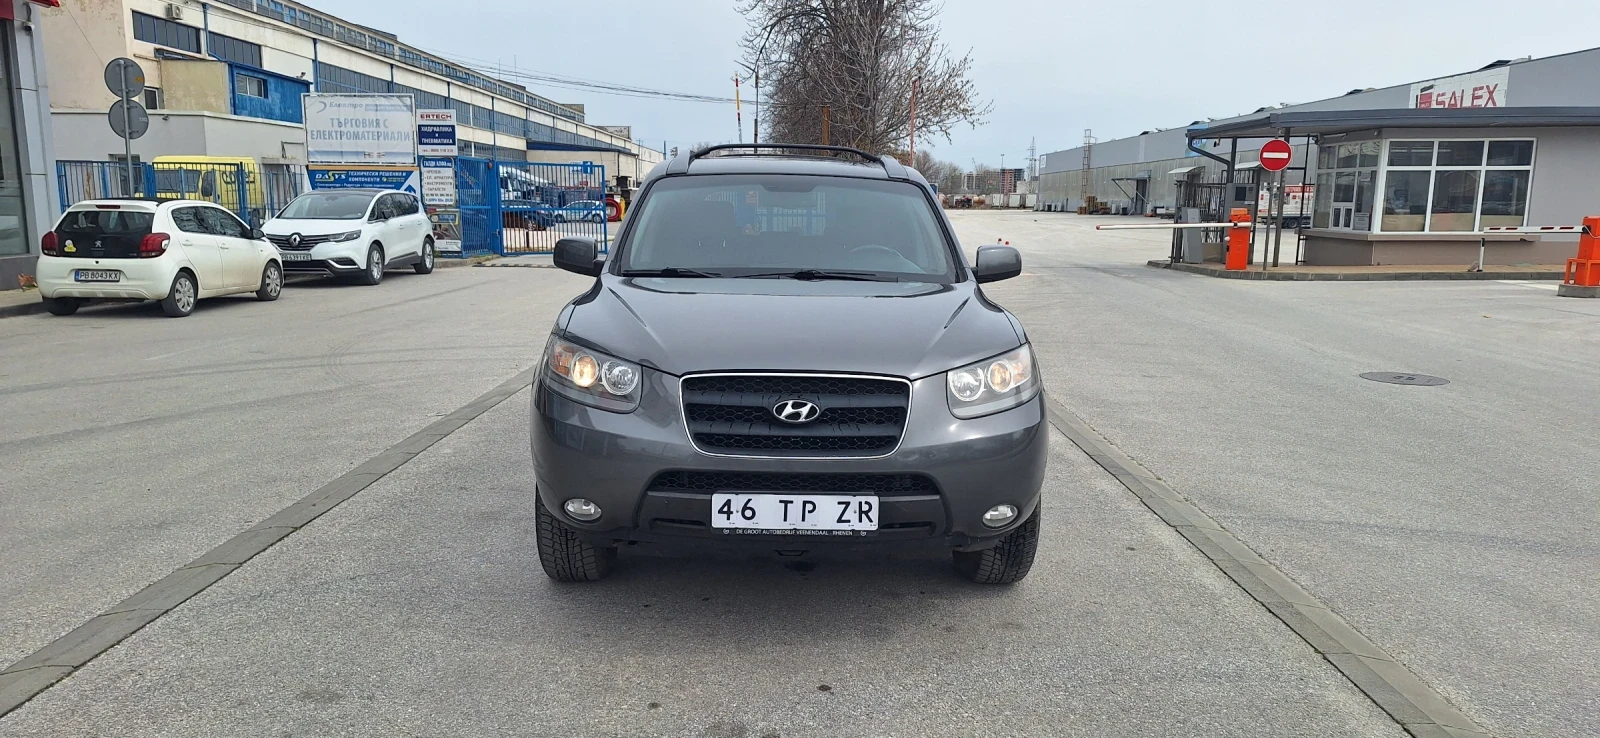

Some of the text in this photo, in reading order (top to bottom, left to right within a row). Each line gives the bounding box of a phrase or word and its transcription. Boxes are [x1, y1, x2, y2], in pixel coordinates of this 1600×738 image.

[1435, 83, 1499, 108] SALEX
[330, 117, 389, 129] ТЪРГОВИЯ С
[310, 130, 410, 141] ЕЛЕКТРОМАТЕРИАЛИ
[315, 171, 347, 182] DASYS
[80, 271, 119, 280] PB 8043 KX
[717, 498, 874, 523] 46 TP ZR
